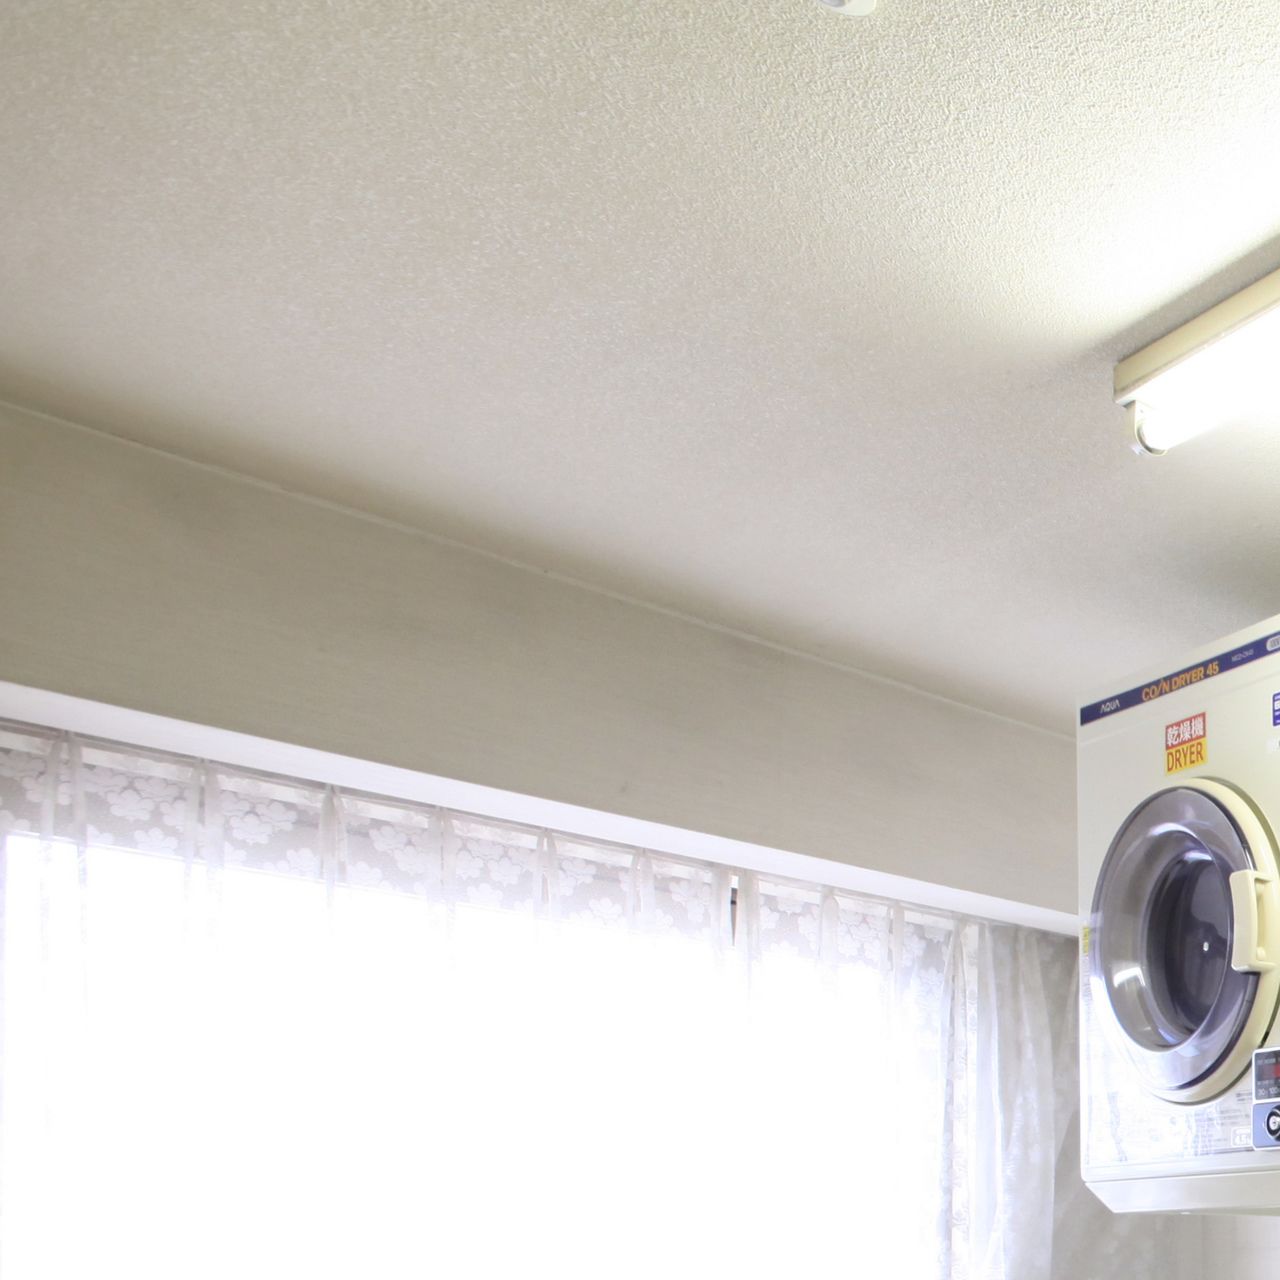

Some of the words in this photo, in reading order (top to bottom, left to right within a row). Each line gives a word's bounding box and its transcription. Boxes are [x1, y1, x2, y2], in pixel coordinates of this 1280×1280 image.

[1172, 666, 1204, 690] DRYER
[1206, 661, 1220, 675] 45
[1167, 742, 1204, 772] DRYER
